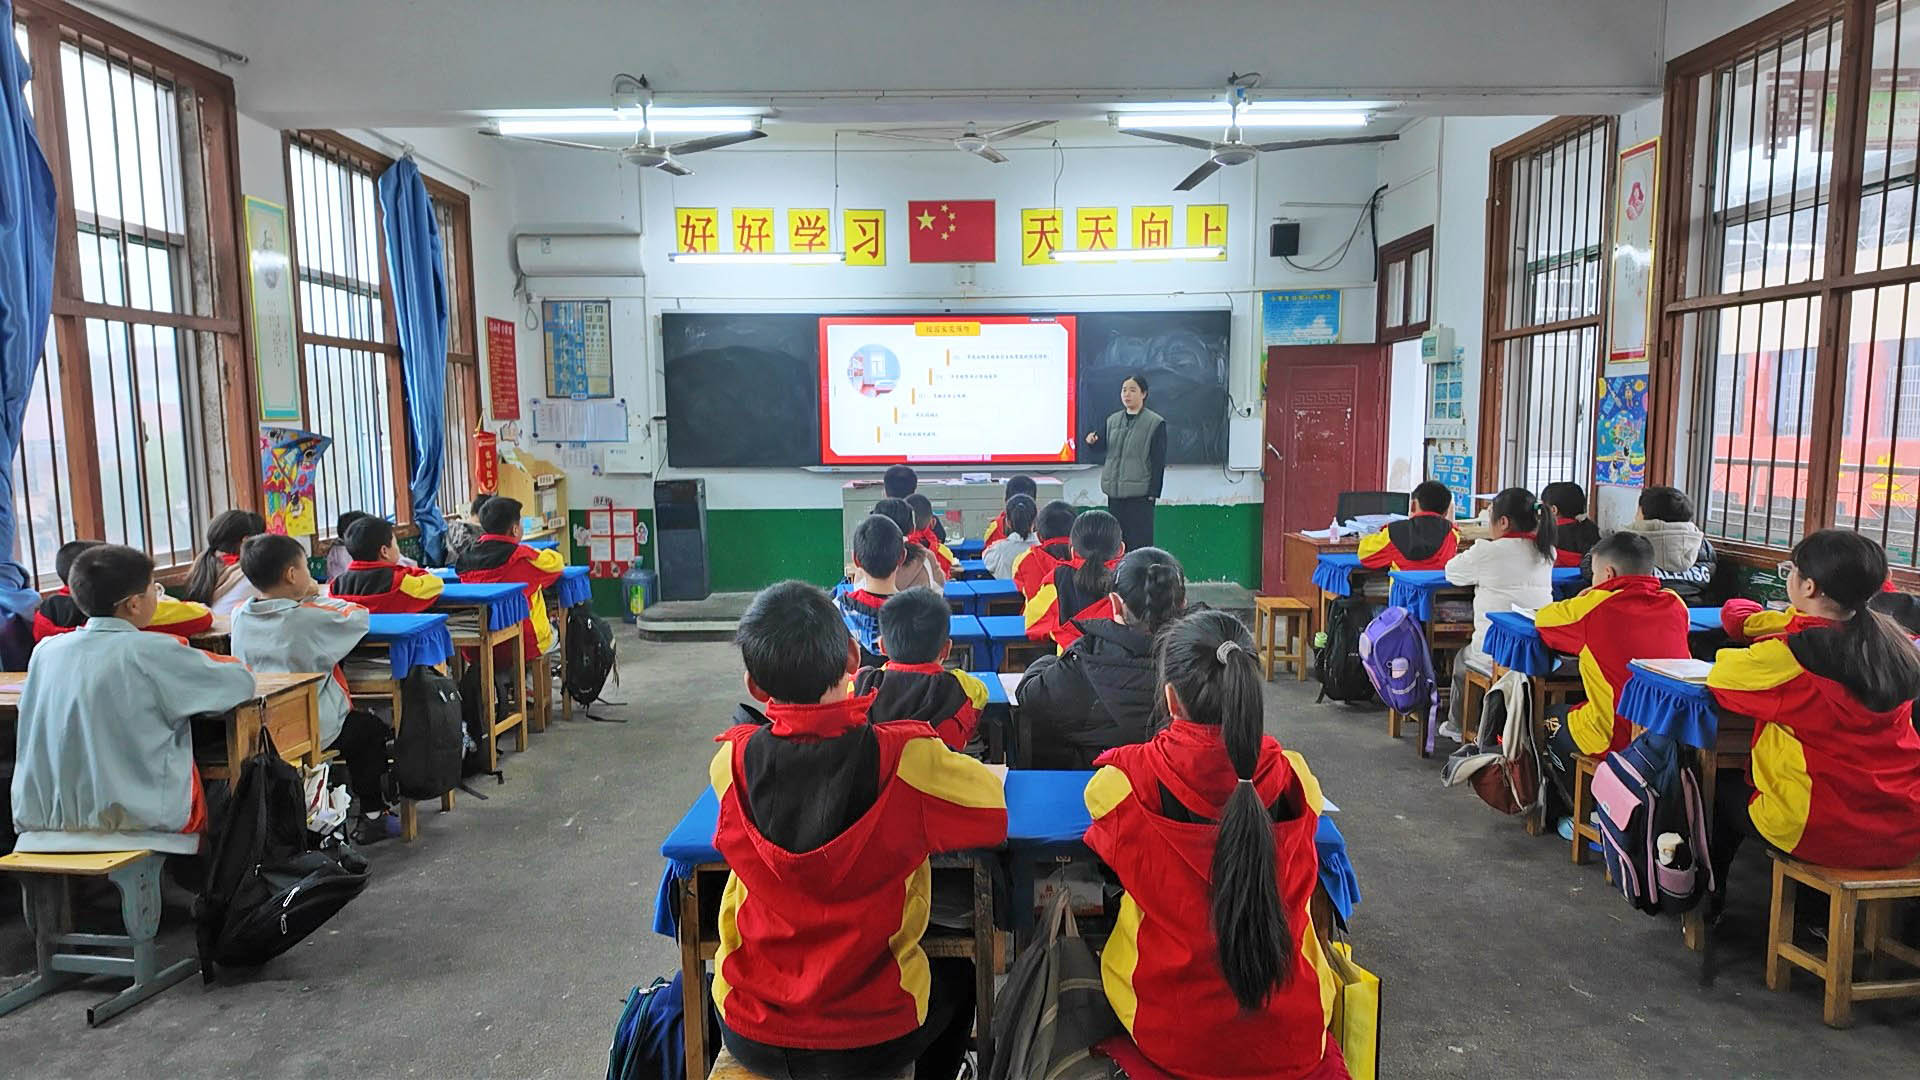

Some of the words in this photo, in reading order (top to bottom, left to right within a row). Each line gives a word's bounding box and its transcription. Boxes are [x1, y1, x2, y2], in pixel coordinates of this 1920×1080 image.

[679, 213, 880, 259] 好好学习
[1026, 211, 1222, 259] 天天向上
